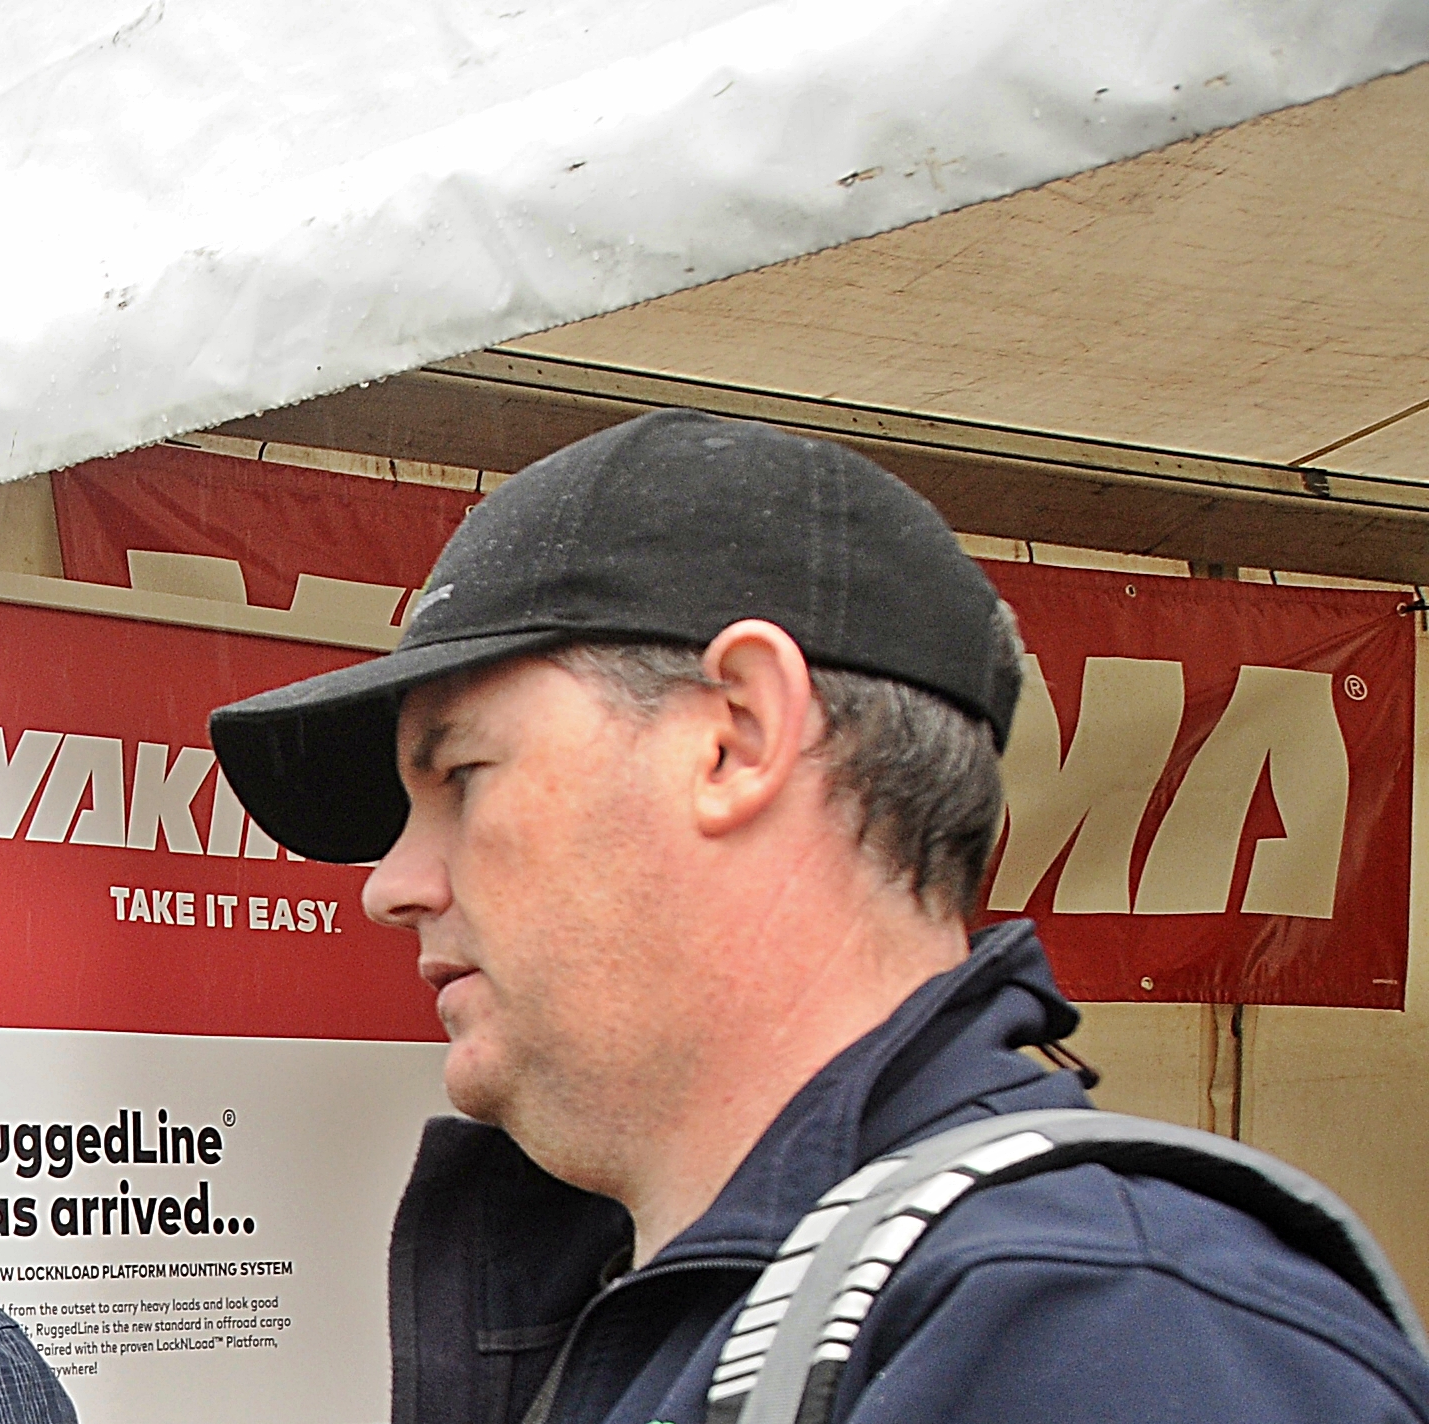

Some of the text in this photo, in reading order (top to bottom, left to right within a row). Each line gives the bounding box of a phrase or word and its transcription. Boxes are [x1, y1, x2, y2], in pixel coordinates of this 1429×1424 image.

[109, 886, 195, 926] TAKE
[206, 894, 238, 928] IT
[50, 1180, 255, 1236] arrived...
[17, 1265, 99, 1281] LOCKNLOAD
[102, 1263, 166, 1279] PLATFORM
[169, 1262, 237, 1277] MOUNTING
[240, 1261, 293, 1276] SYSTEM
[9, 1304, 36, 1317] from
[39, 1303, 57, 1316] the
[61, 1303, 96, 1315] outset
[98, 1302, 109, 1314] to
[113, 1303, 138, 1316] carry
[140, 1300, 170, 1314] heavy
[172, 1299, 200, 1311] loads
[203, 1298, 223, 1310] and
[225, 1297, 248, 1309] look
[251, 1296, 279, 1311] good
[36, 1322, 99, 1339] RuggedLine
[102, 1321, 110, 1334] is
[112, 1321, 129, 1333] the
[132, 1322, 152, 1333] new
[155, 1317, 201, 1331] standard
[204, 1317, 214, 1330] in
[216, 1316, 257, 1329] offroad
[260, 1317, 291, 1330] cargo
[37, 1342, 72, 1356] Paired
[74, 1342, 98, 1355] with
[100, 1341, 118, 1354] the
[120, 1342, 154, 1356] proven
[226, 1335, 278, 1349] Platform,
